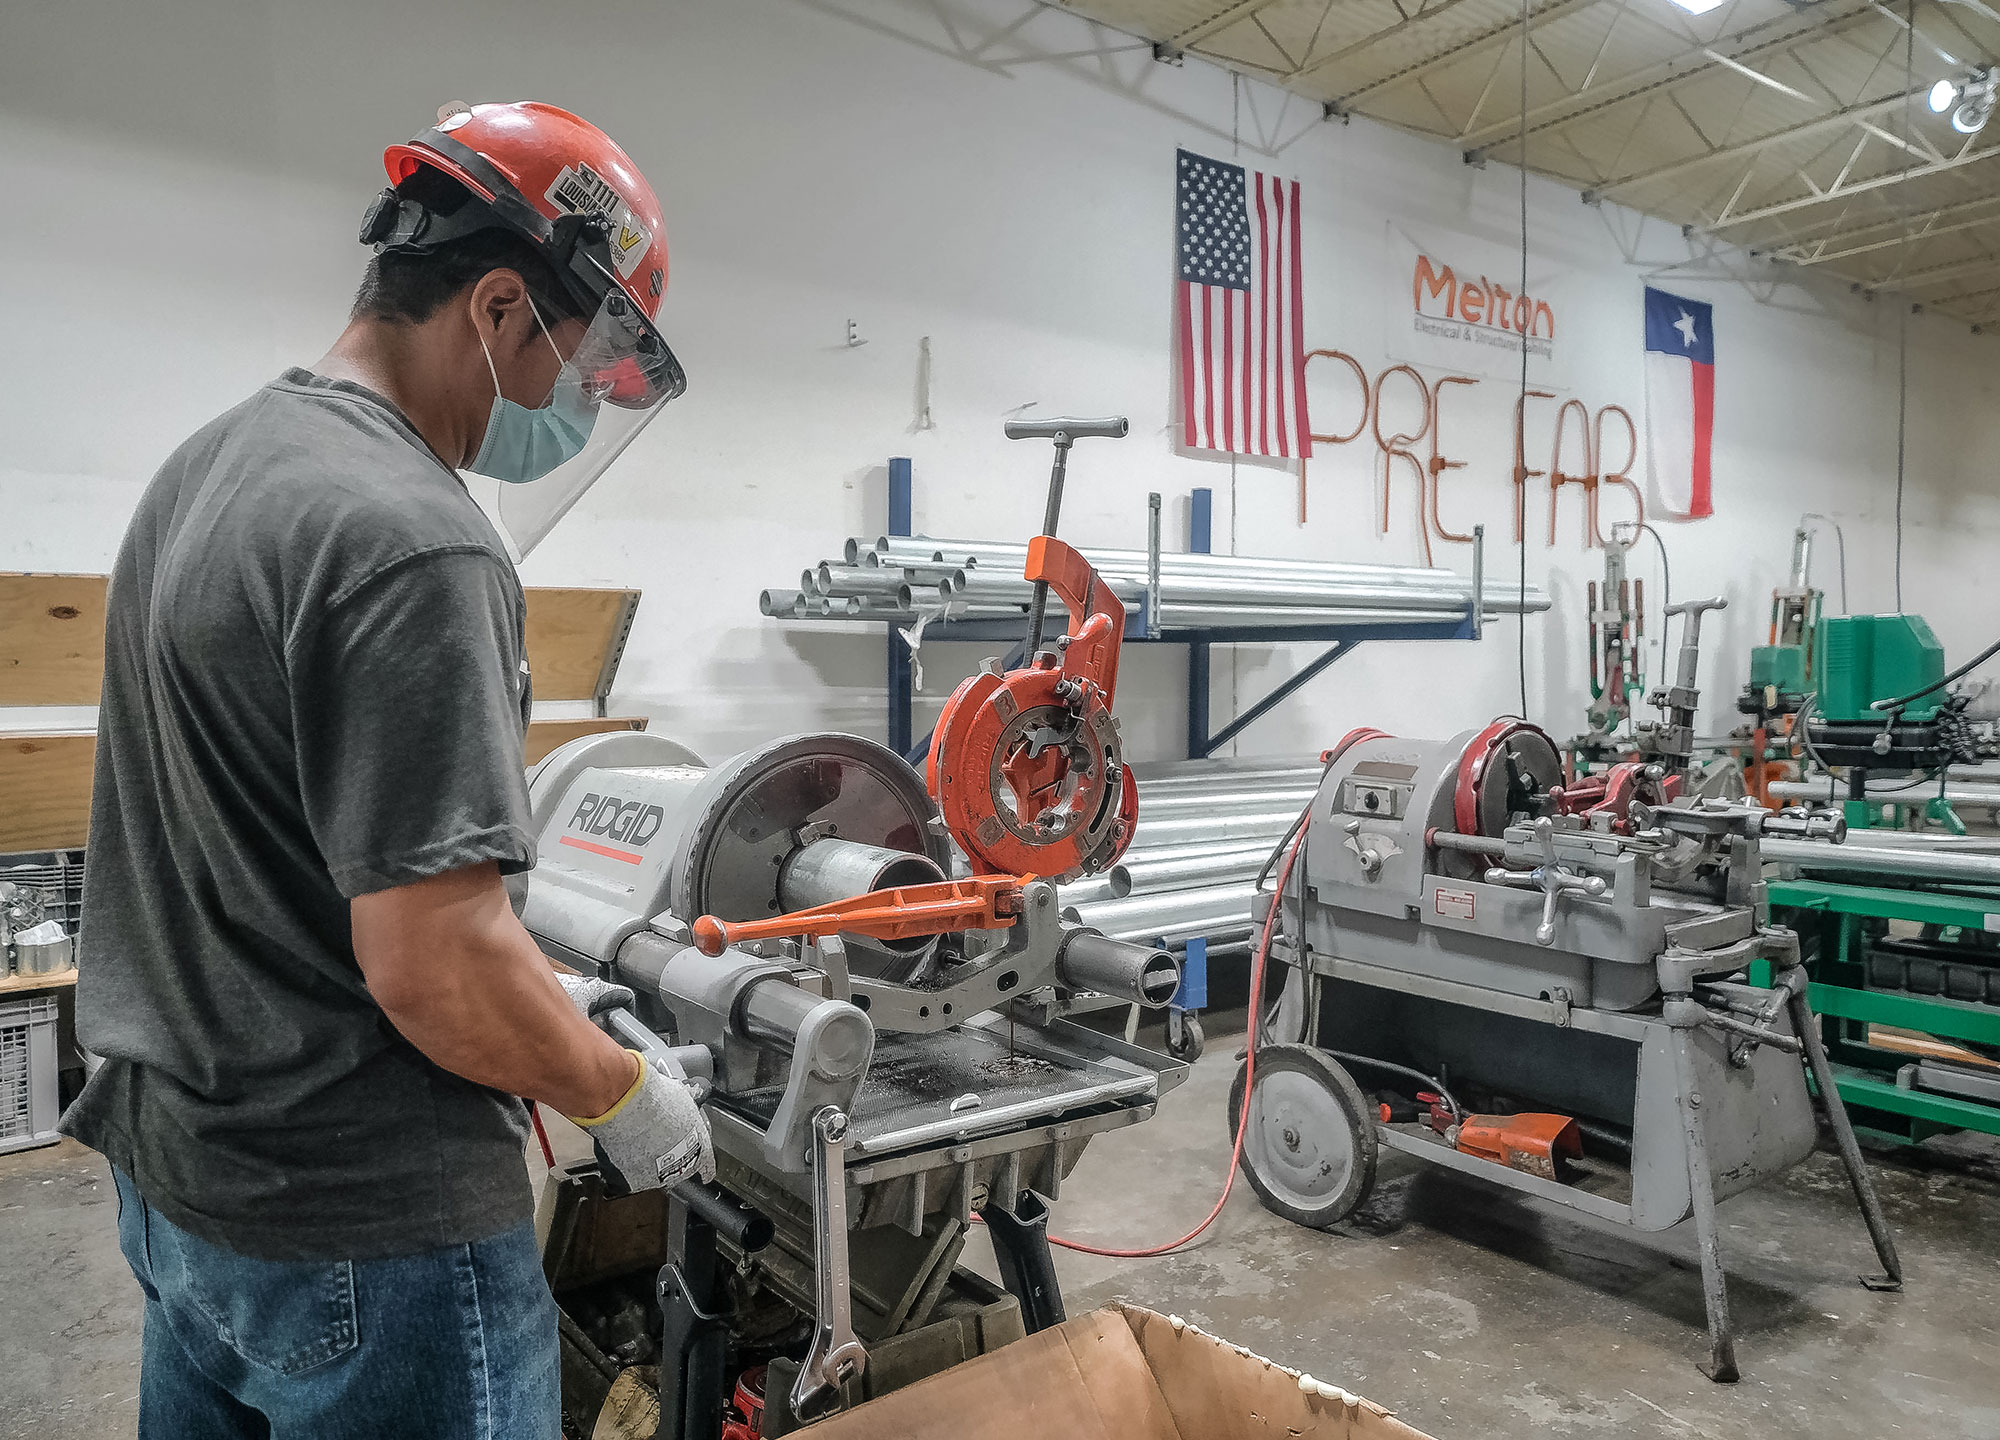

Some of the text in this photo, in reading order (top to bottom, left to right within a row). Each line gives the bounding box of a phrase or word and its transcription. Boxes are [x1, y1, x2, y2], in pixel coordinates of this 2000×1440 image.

[560, 176, 609, 217] LOUISIA
[1413, 254, 1555, 340] Melton
[1301, 350, 1645, 568] PRE FAB
[567, 792, 664, 847] RIDGID
